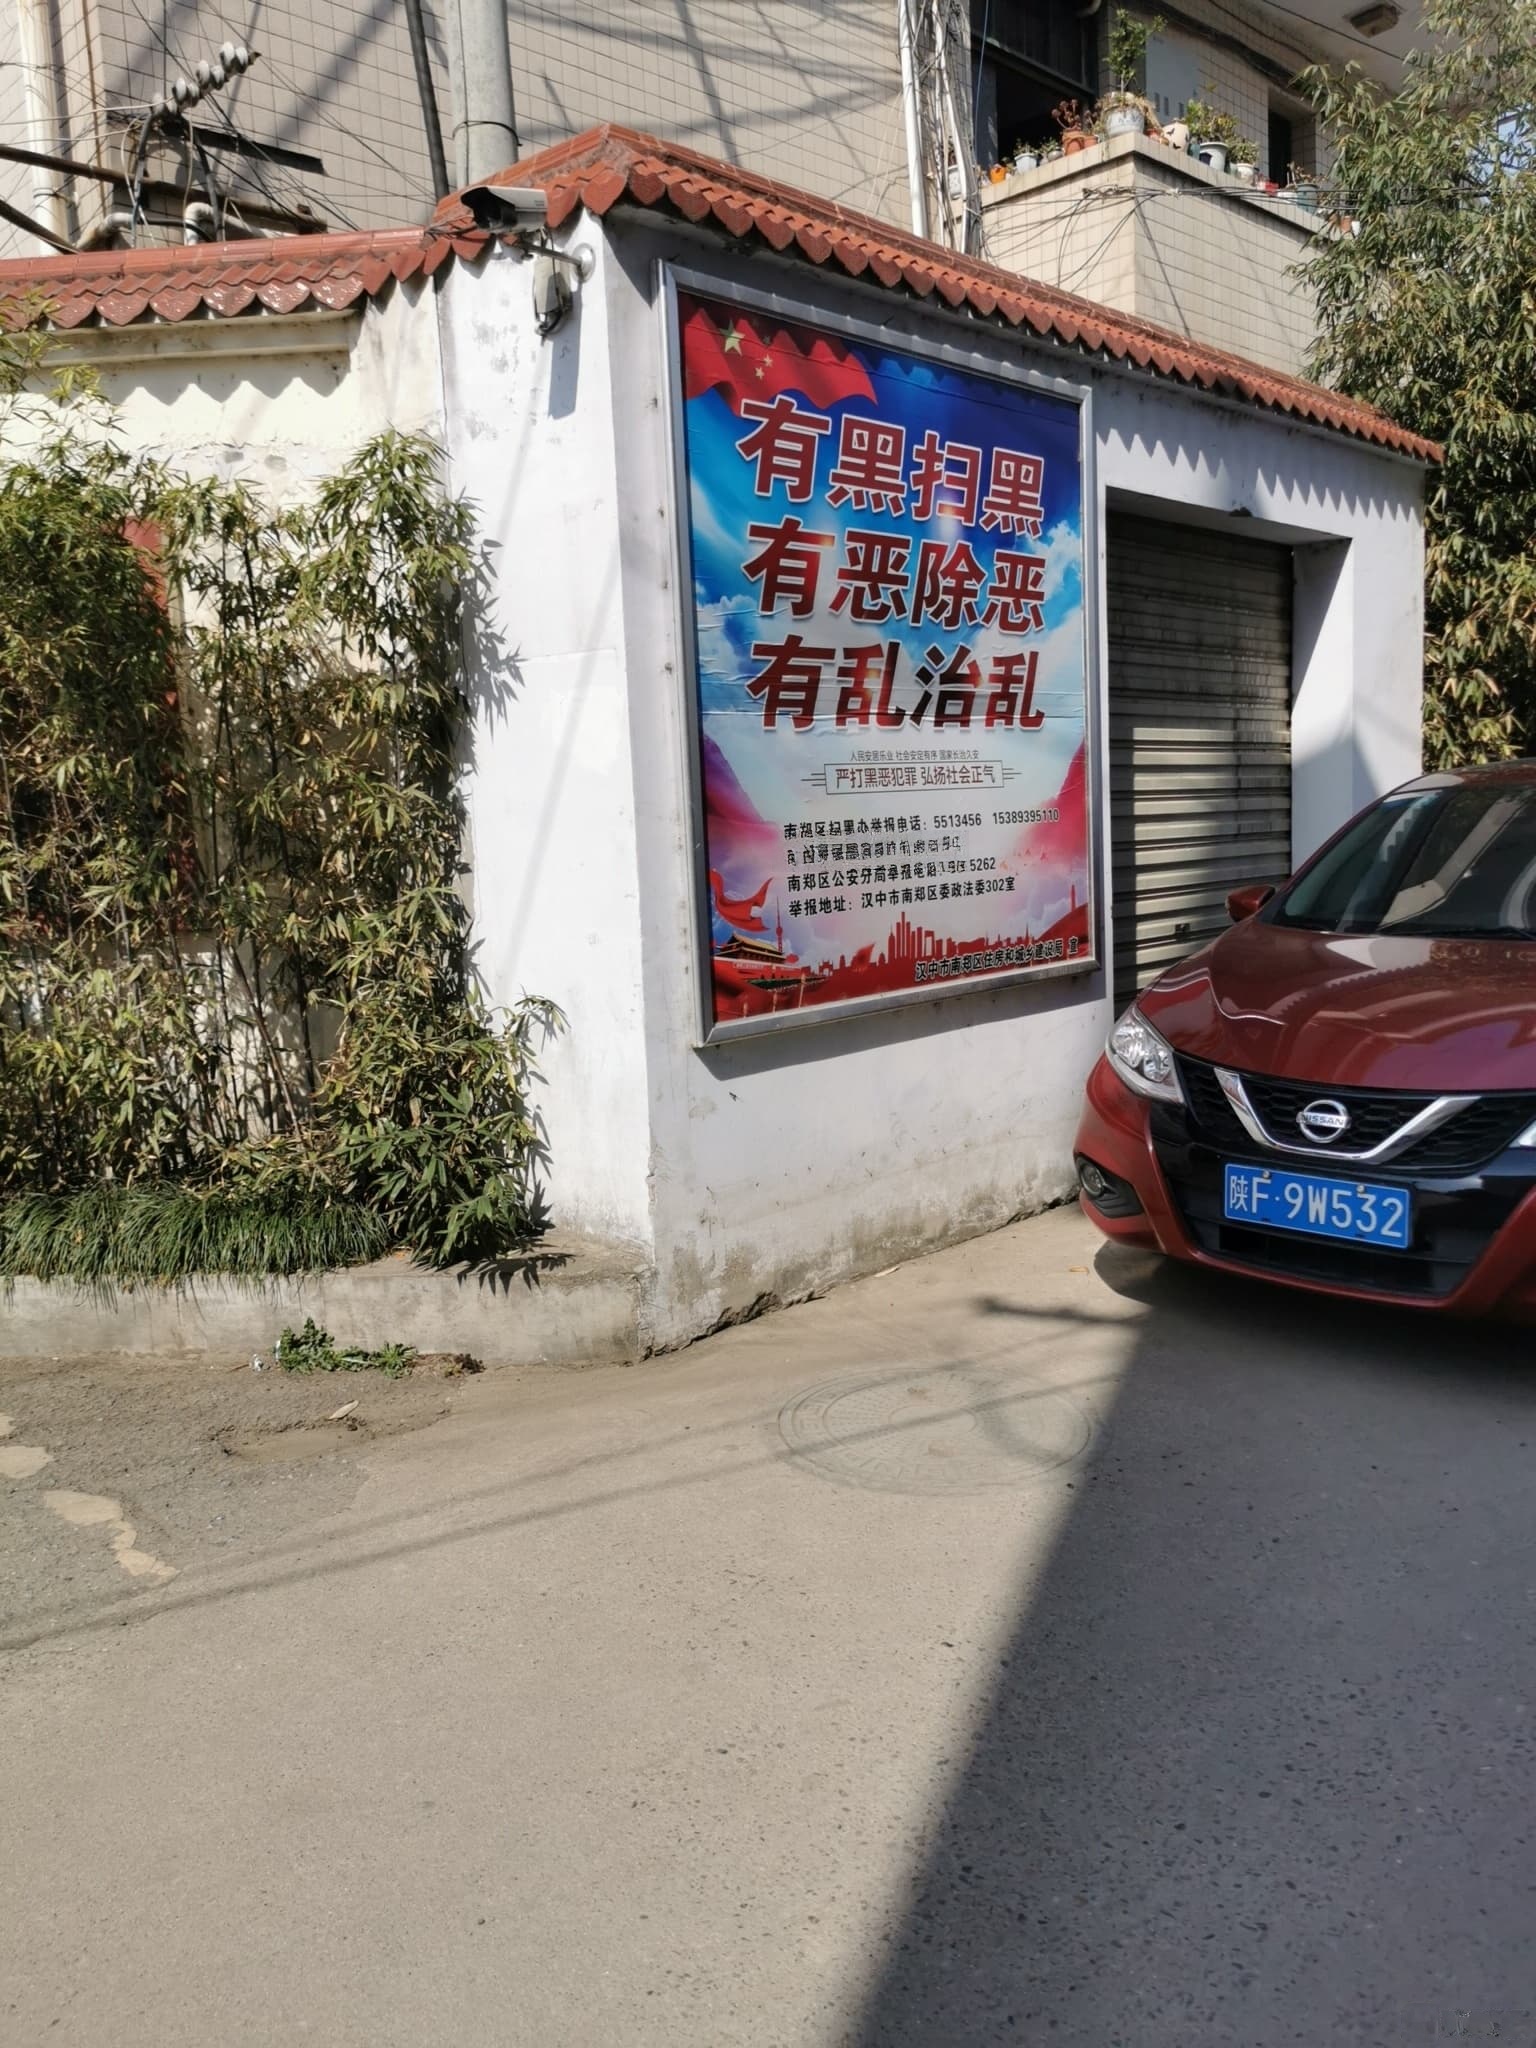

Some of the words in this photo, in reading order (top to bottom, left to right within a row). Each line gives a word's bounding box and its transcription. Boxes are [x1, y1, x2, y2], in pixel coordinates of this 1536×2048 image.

[736, 394, 1045, 539] 有黑扫黑
[742, 517, 1046, 635] 有恶除恶
[745, 634, 1046, 732] 有乱治乱
[835, 766, 918, 789] 严打黑恶犯罪
[920, 764, 996, 785] 弘扬社会正气
[992, 809, 1060, 825] 15389395110
[1301, 1113, 1345, 1126] NISSAN
